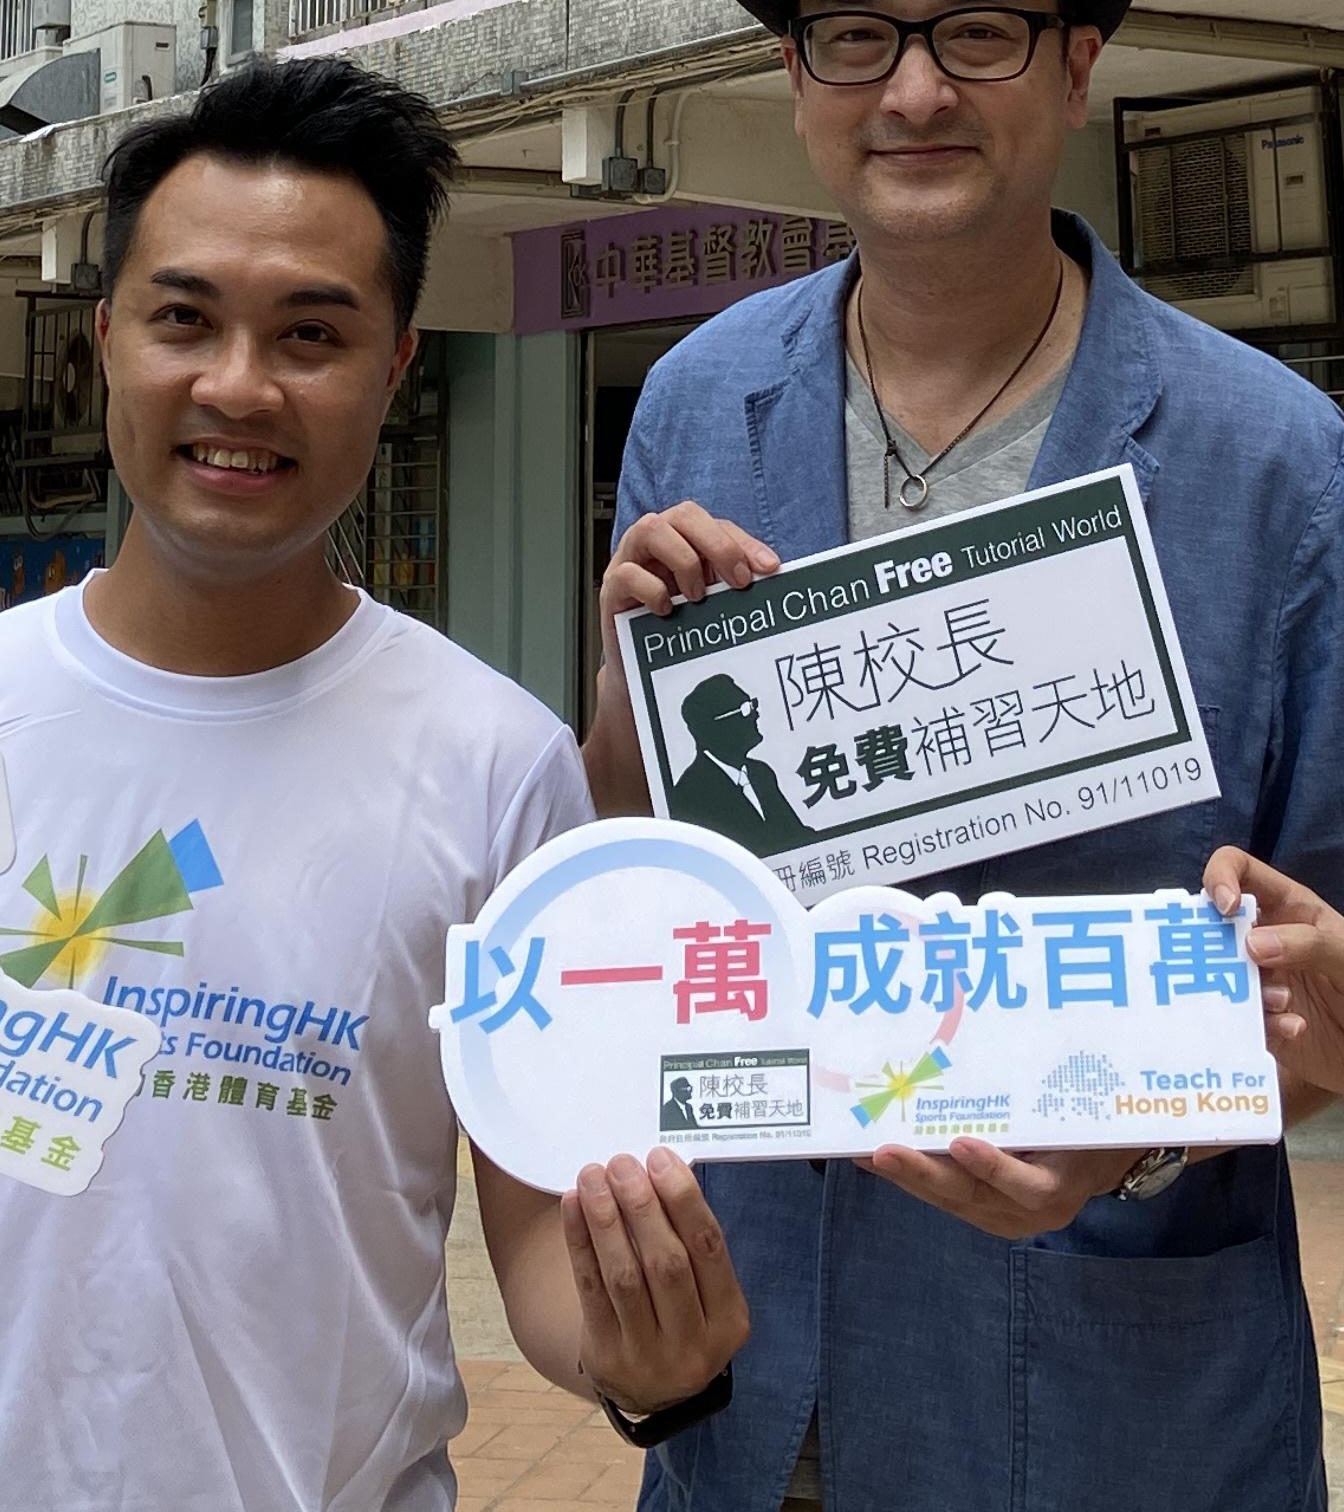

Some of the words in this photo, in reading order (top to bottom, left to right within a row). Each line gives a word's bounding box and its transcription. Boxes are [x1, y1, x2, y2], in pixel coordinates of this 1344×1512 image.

[644, 599, 775, 664] Principal
[782, 576, 871, 622] Chan
[873, 549, 954, 596] Free
[961, 532, 1046, 570] Tutorial
[1052, 504, 1123, 544] World
[774, 598, 1015, 732] 陳校長
[795, 659, 1156, 809] 免費補習天地
[862, 808, 1017, 870] Registration
[1025, 785, 1071, 826] No.
[1077, 755, 1203, 811] 91/11019
[450, 919, 773, 1035] 以一萬
[807, 901, 1250, 1020] 成就百萬
[103, 975, 369, 1051] InspiringHK
[185, 1032, 352, 1086] Foundation
[734, 1056, 758, 1067] Free
[699, 1073, 769, 1098] 陳校長
[1140, 1068, 1221, 1091] Teach
[1232, 1072, 1266, 1088] For
[699, 1099, 804, 1120] 免費補習天地
[915, 1112, 947, 1123] Sports
[916, 1094, 1010, 1112] InspiringHK
[1115, 1094, 1187, 1117] Hong
[1197, 1092, 1269, 1115] Kong
